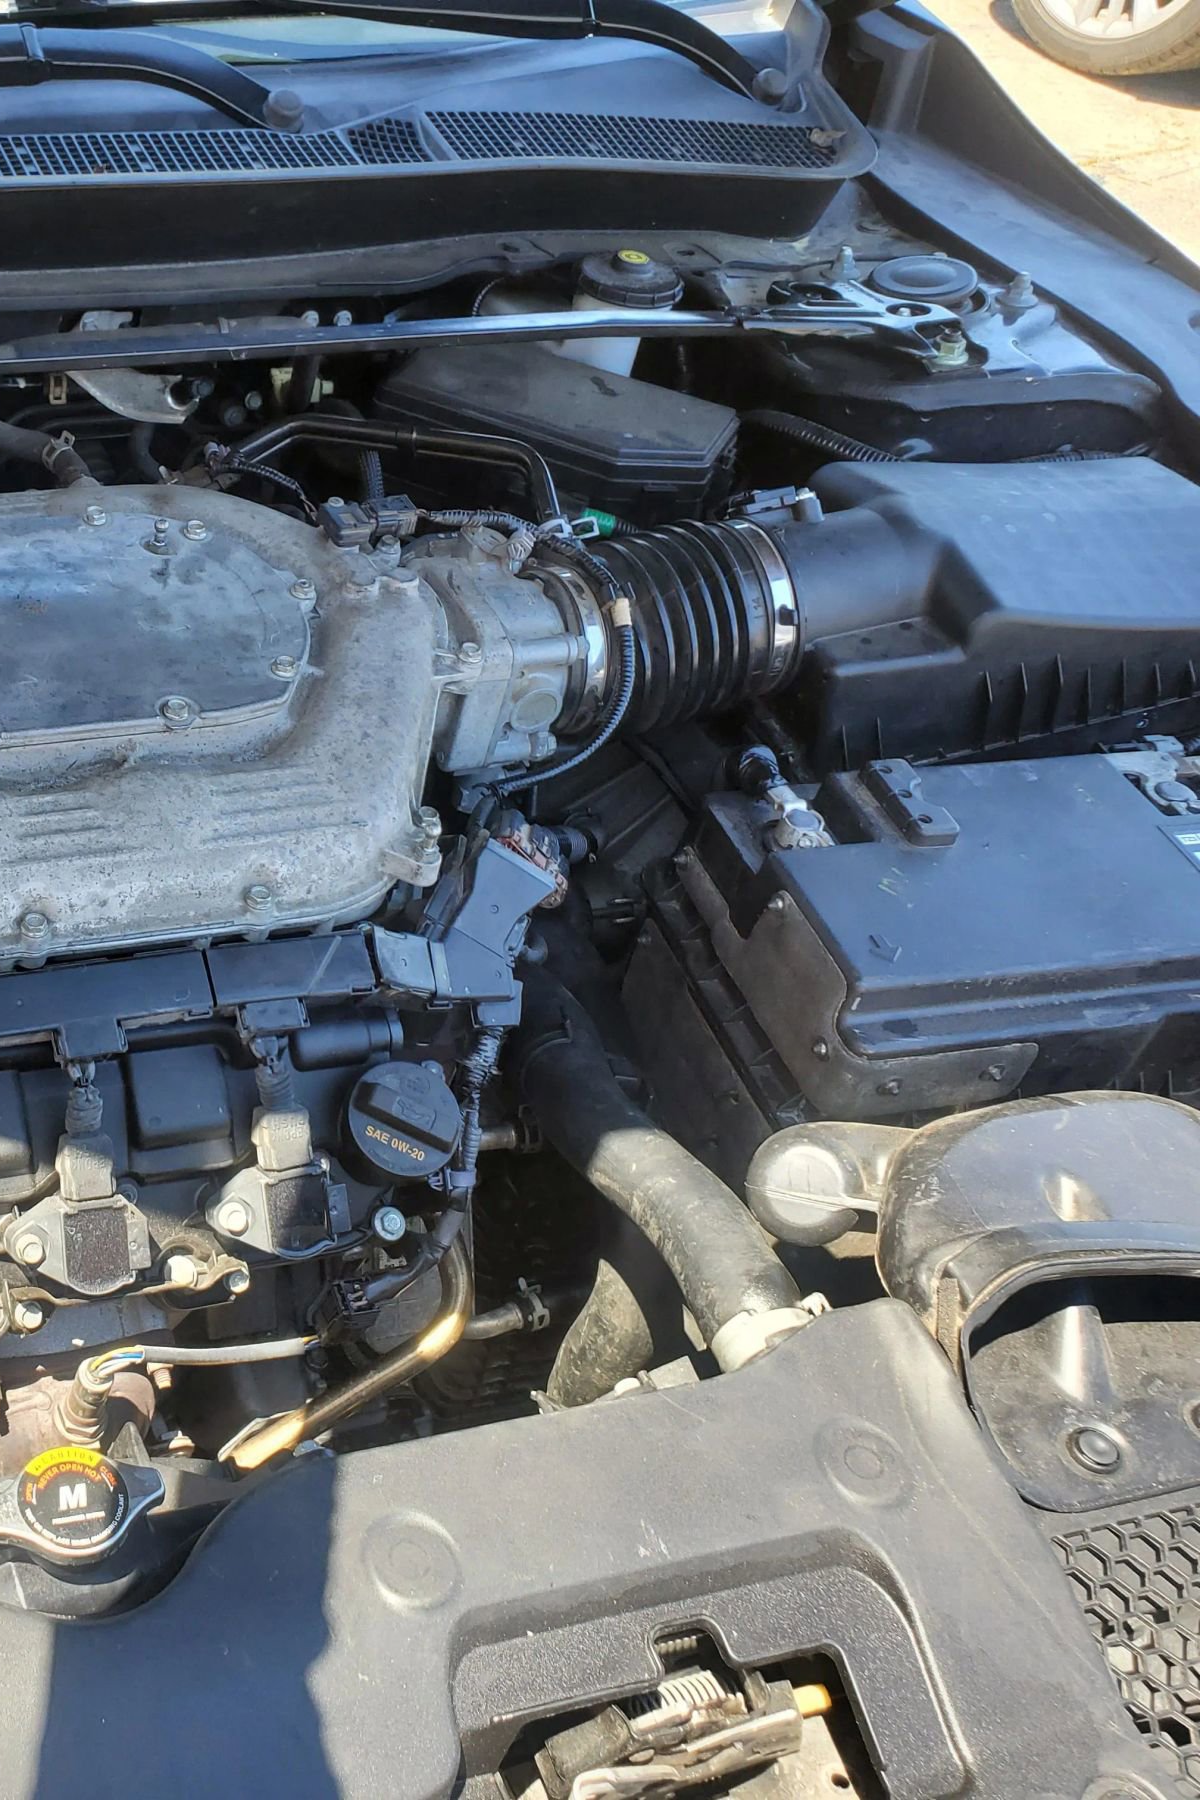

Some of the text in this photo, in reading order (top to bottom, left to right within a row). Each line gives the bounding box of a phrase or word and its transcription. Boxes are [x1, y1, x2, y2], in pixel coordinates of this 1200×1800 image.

[364, 1124, 426, 1161] SAE 0W-20
[38, 1462, 103, 1489] NEVER OPEN HOT
[58, 1482, 88, 1511] M
[116, 1493, 125, 1522] COOLANT
